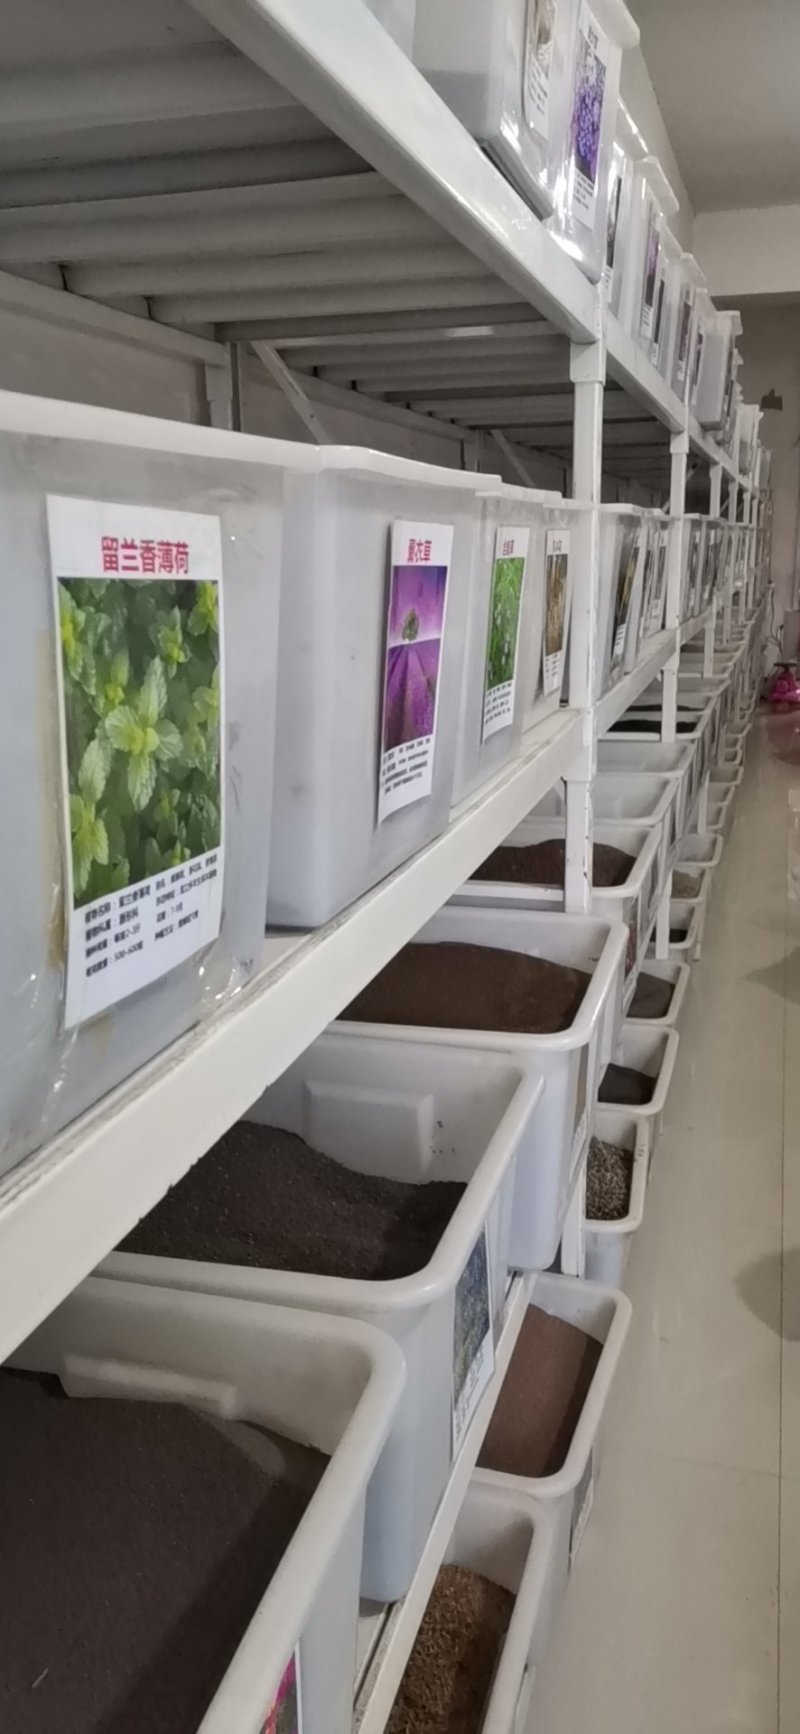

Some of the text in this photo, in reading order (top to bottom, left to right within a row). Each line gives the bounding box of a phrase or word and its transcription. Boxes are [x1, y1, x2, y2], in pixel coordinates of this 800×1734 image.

[101, 536, 189, 575] 留兰香薄荷
